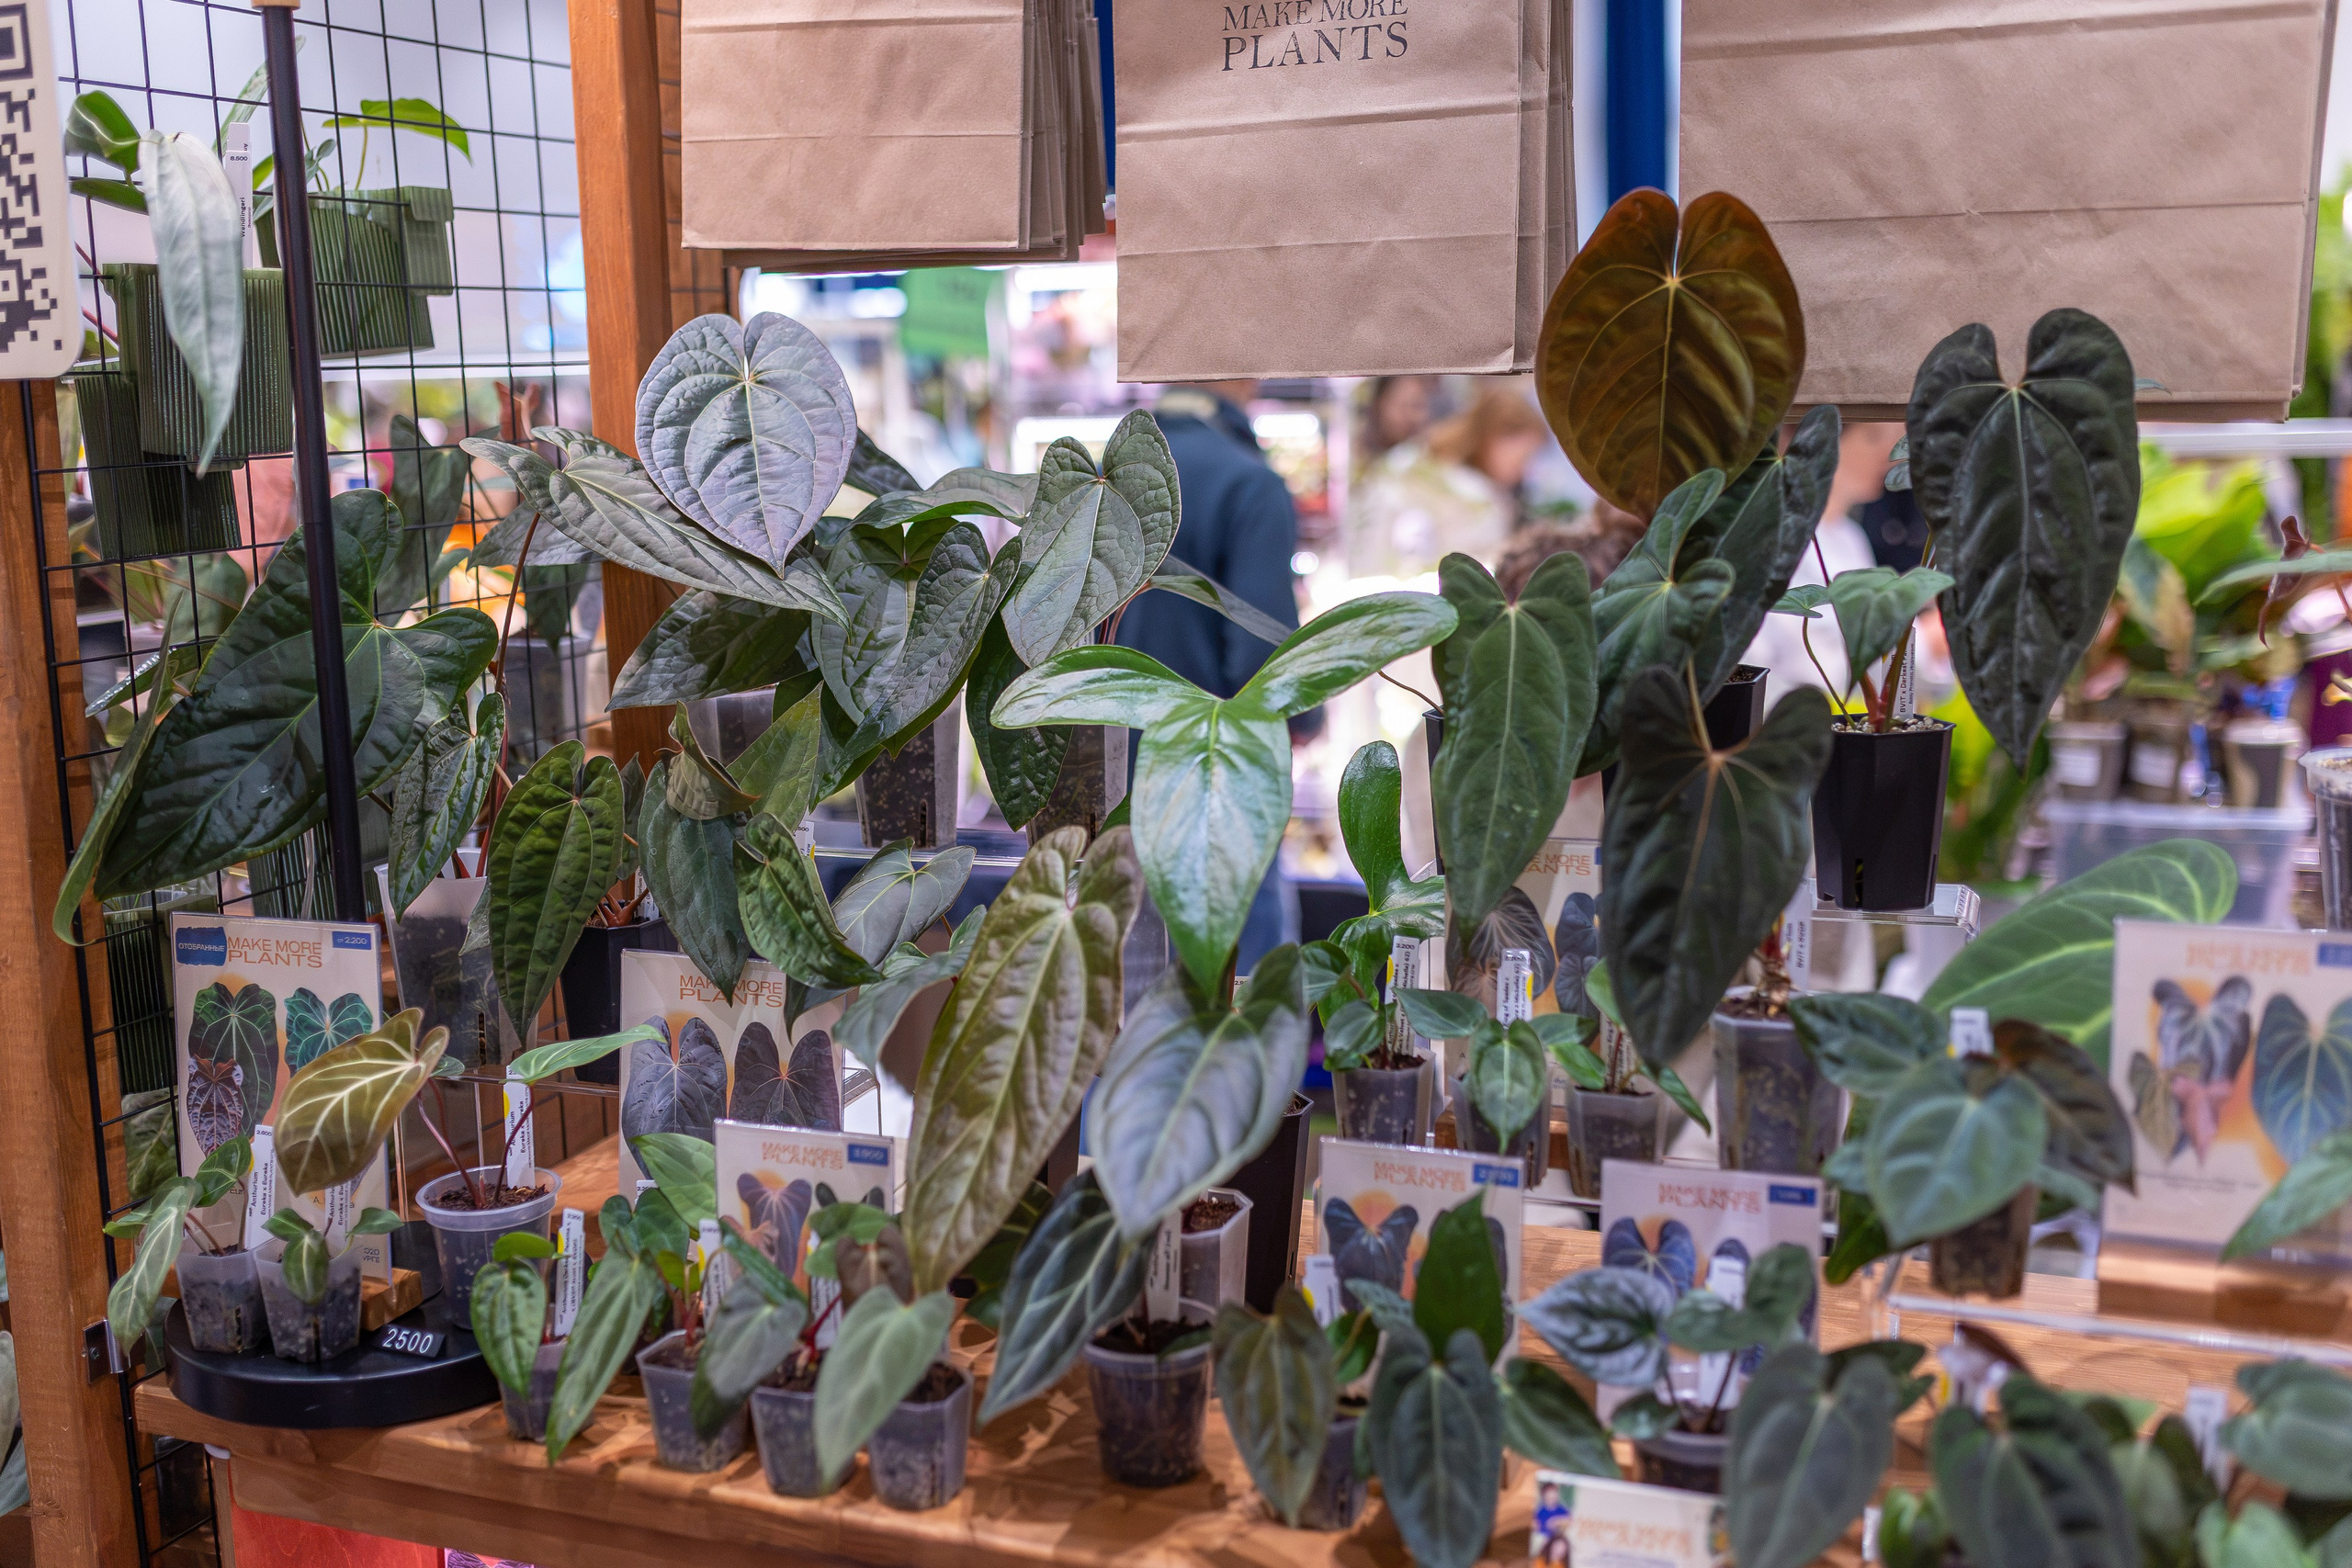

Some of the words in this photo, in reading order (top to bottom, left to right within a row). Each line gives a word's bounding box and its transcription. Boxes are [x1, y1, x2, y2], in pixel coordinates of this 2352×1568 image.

[1222, 0, 1313, 31] MAKE
[1318, 0, 1408, 23] MORE
[1221, 21, 1408, 72] PLANTS
[1544, 853, 1590, 865] MORE
[1526, 863, 1590, 876] ANTS
[177, 942, 226, 953] ОТОБРАННЫЕ
[227, 937, 272, 952] MAKE
[275, 939, 322, 954] MORE
[228, 950, 322, 968] PLANTS
[680, 975, 717, 989] MAK
[736, 979, 783, 994] MORE
[680, 988, 783, 1008] PLANTS
[382, 1328, 434, 1354] 2500
